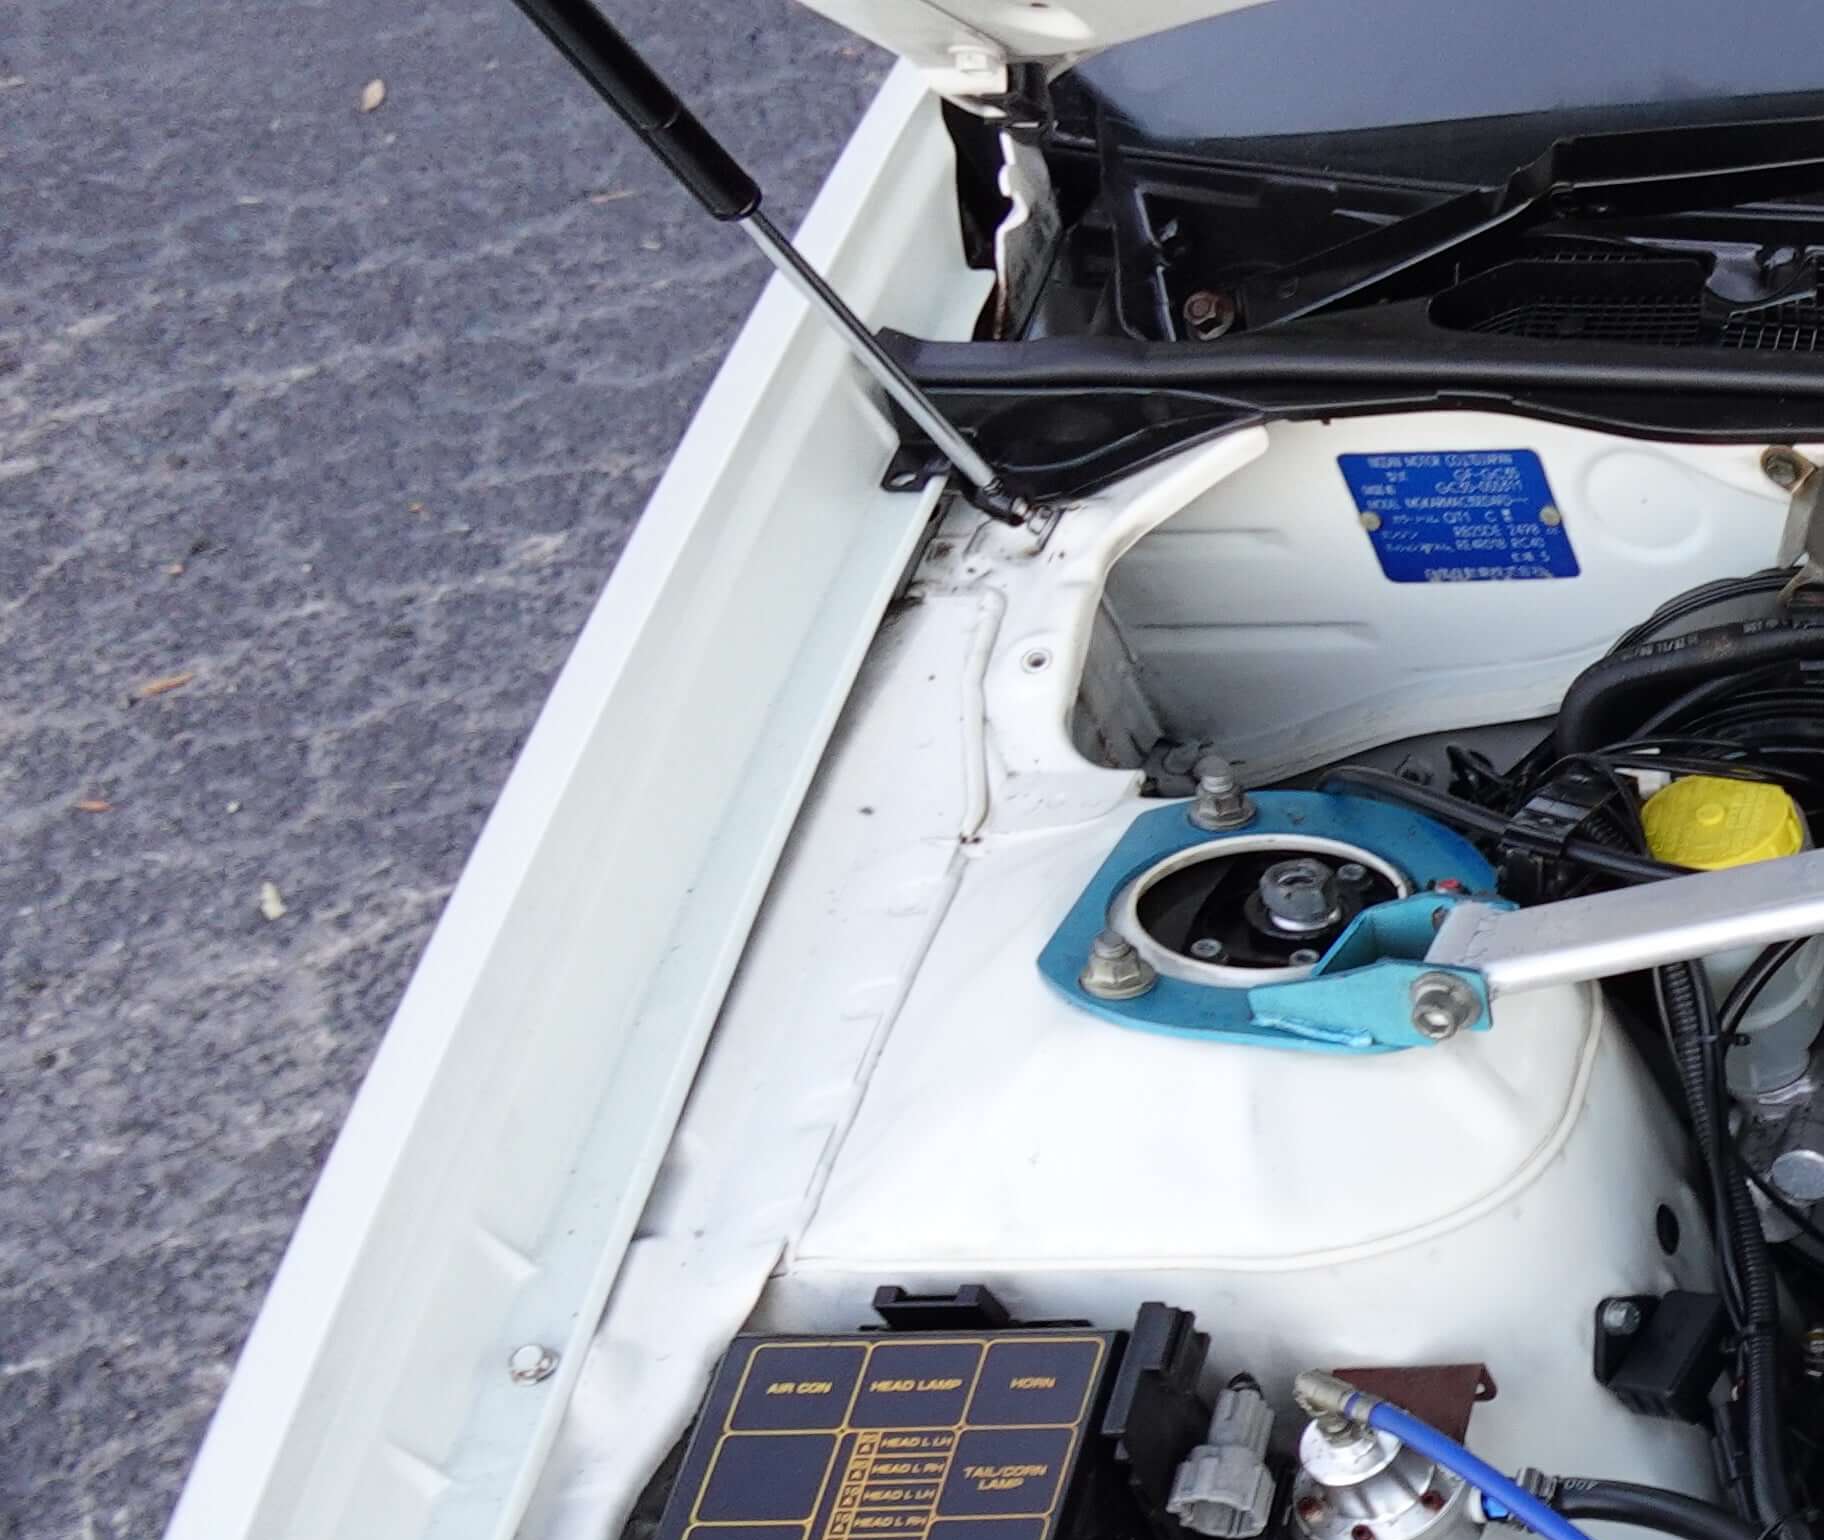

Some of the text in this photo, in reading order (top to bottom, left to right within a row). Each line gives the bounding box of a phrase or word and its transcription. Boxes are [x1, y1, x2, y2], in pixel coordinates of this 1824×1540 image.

[767, 1381, 797, 1395] AIR
[870, 1378, 962, 1393] HEAD LAMP
[1010, 1377, 1056, 1391] HORN
[976, 1477, 1025, 1490] LAMP
